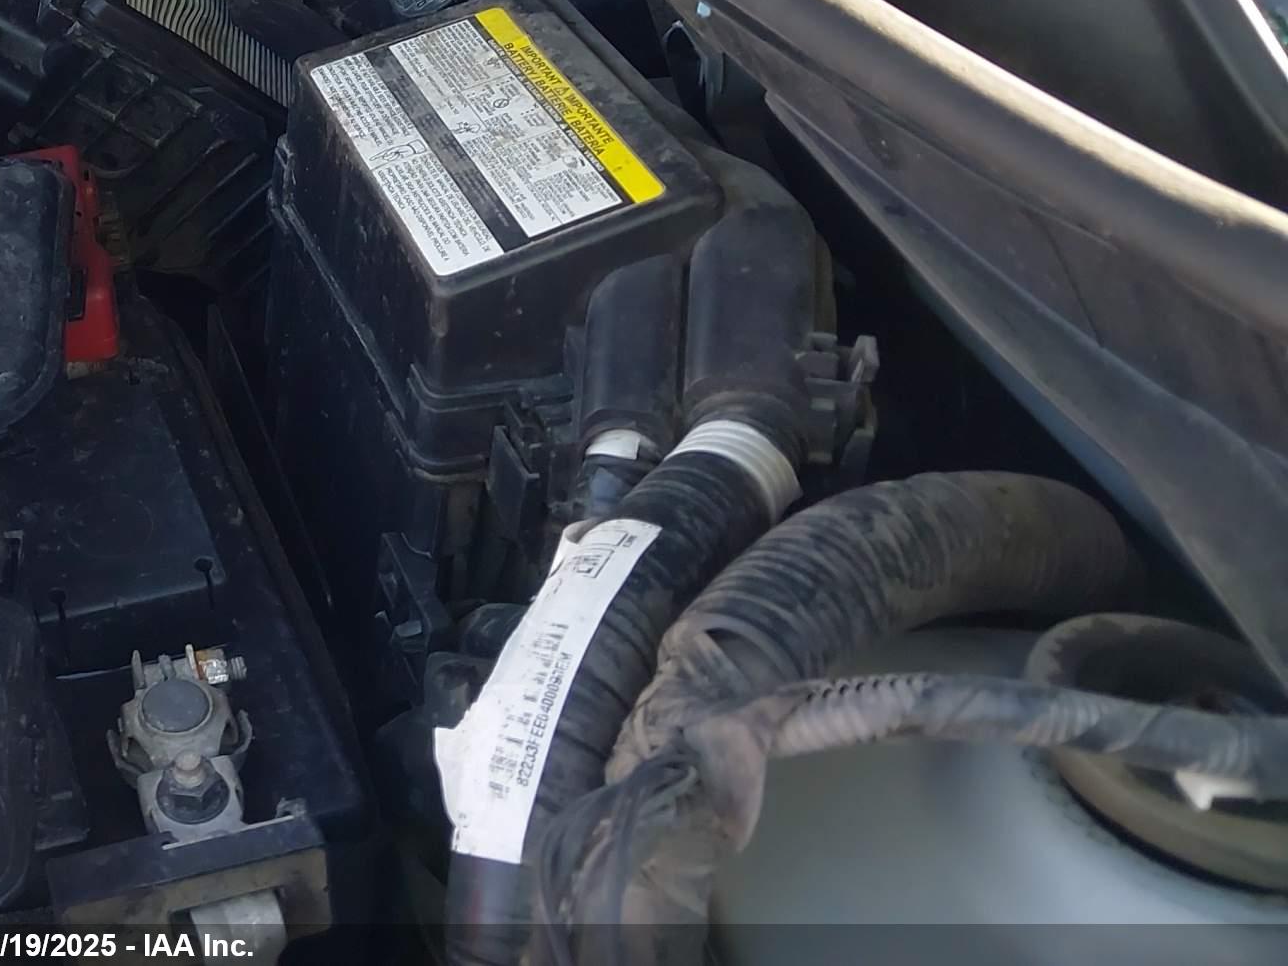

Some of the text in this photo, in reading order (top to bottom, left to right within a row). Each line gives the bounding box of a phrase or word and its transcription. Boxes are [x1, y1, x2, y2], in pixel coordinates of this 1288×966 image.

[502, 41, 537, 77] BATTERY
[534, 78, 572, 116] BATTERIE
[520, 44, 614, 145] IMPORTANT IMPORTANTE
